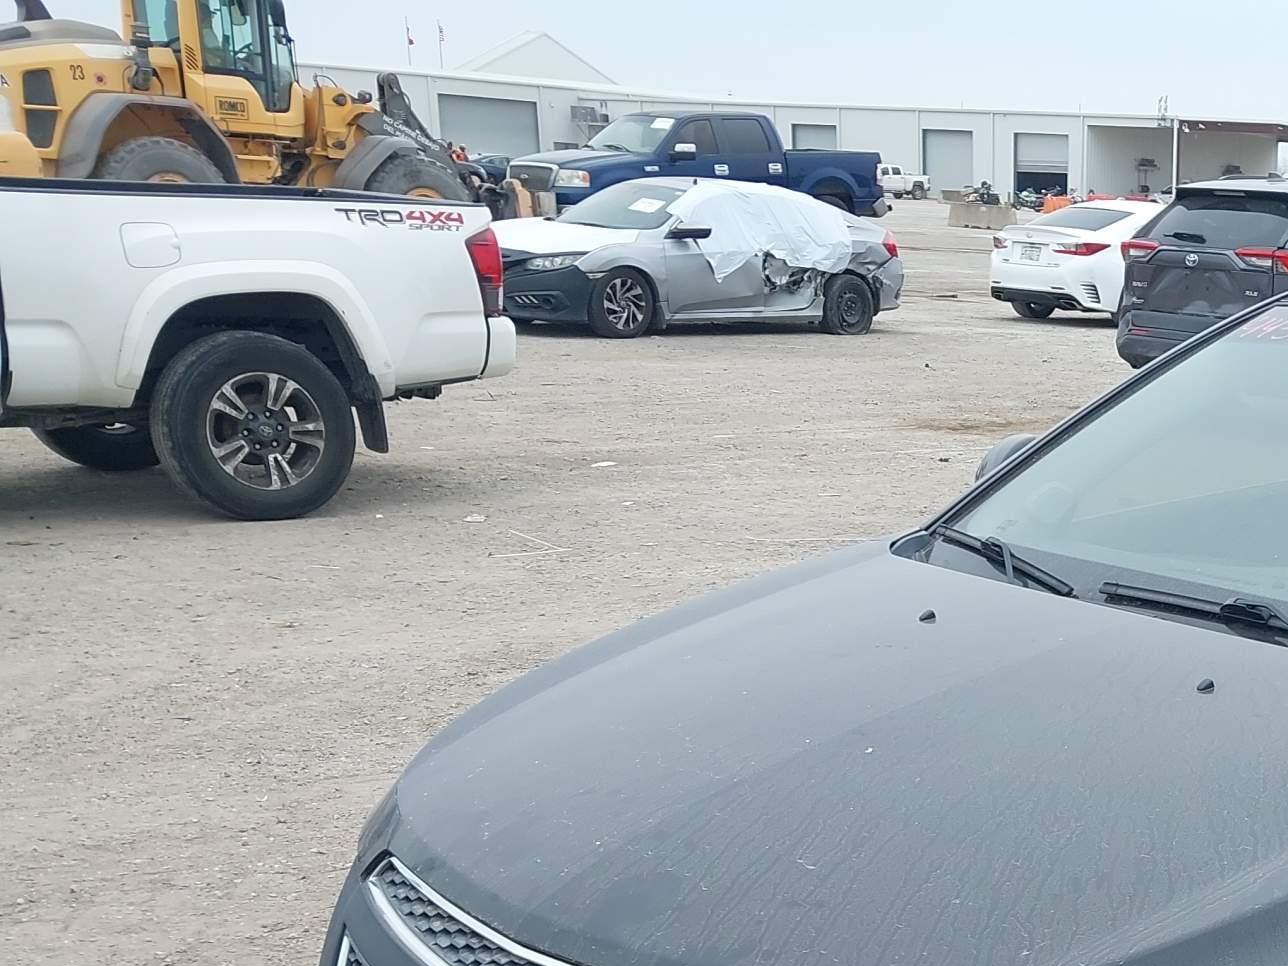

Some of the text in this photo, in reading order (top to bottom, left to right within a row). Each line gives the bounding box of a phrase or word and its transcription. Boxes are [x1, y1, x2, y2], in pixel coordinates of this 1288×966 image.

[69, 64, 85, 81] 23
[334, 208, 405, 228] TRD
[408, 223, 463, 232] SPORT
